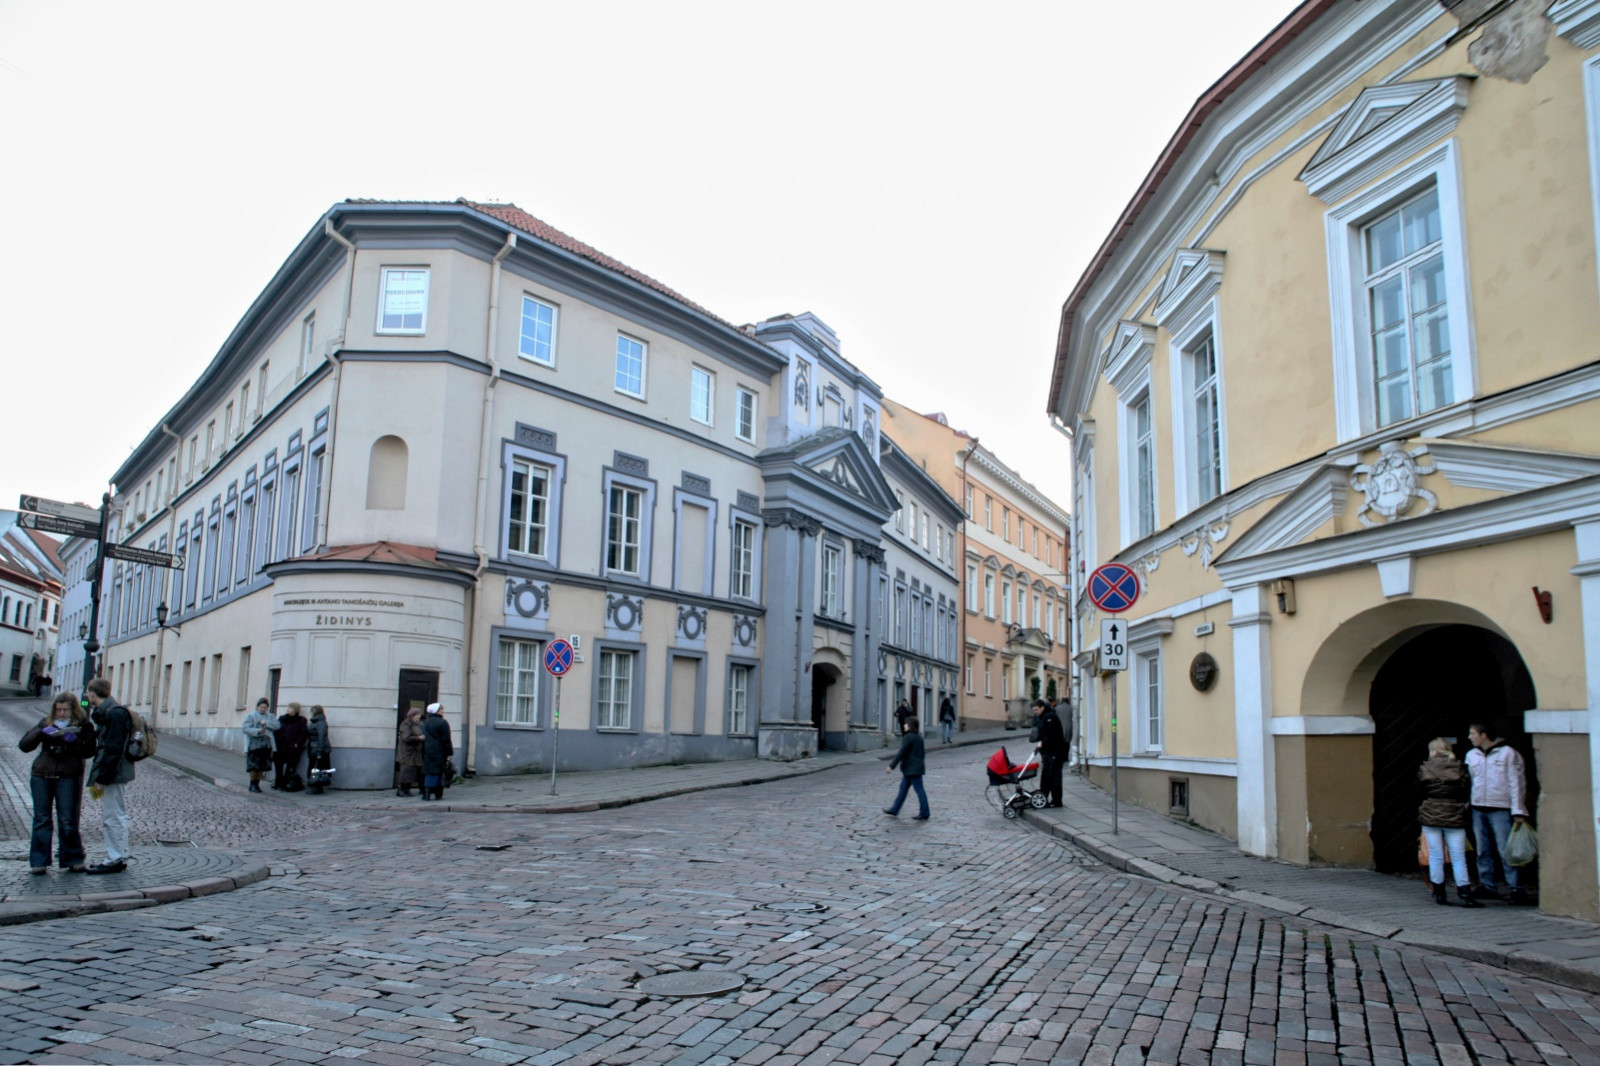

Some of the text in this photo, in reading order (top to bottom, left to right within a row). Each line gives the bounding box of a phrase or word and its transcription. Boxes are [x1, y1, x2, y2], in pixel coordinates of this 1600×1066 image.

[316, 614, 372, 626] ŽIDINYS
[1104, 643, 1124, 656] 30
[1108, 658, 1120, 666] m
